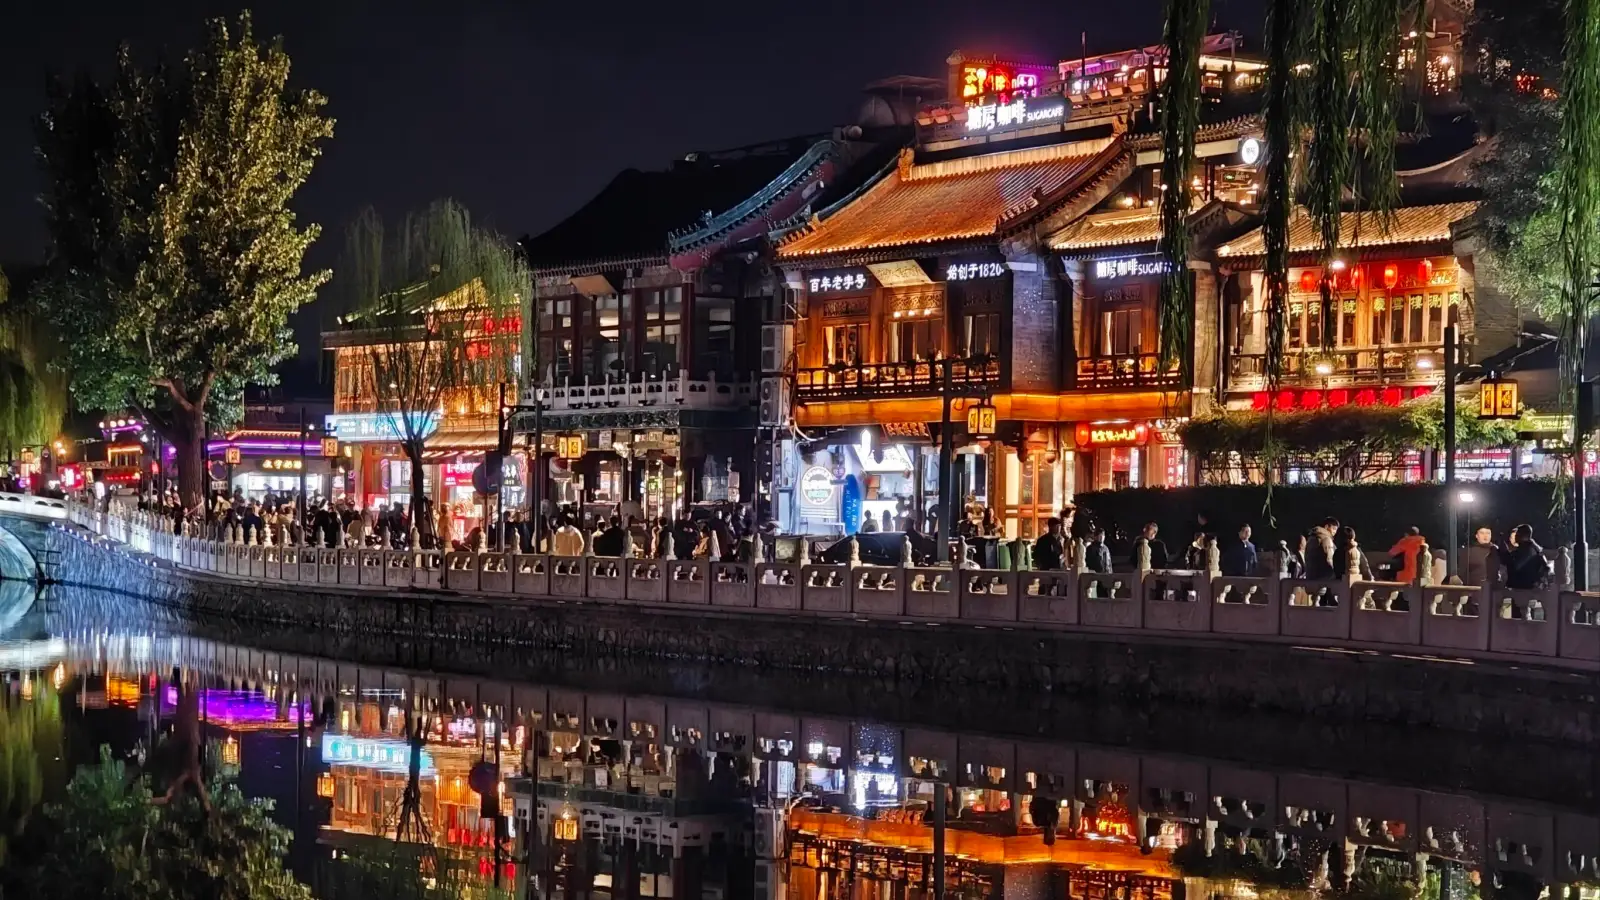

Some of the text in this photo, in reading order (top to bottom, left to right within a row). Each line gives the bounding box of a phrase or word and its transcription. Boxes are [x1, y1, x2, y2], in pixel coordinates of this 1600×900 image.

[1027, 107, 1064, 122] SUGARCAFE
[946, 263, 1004, 281] 始创于1820
[809, 273, 866, 293] 百年老字号
